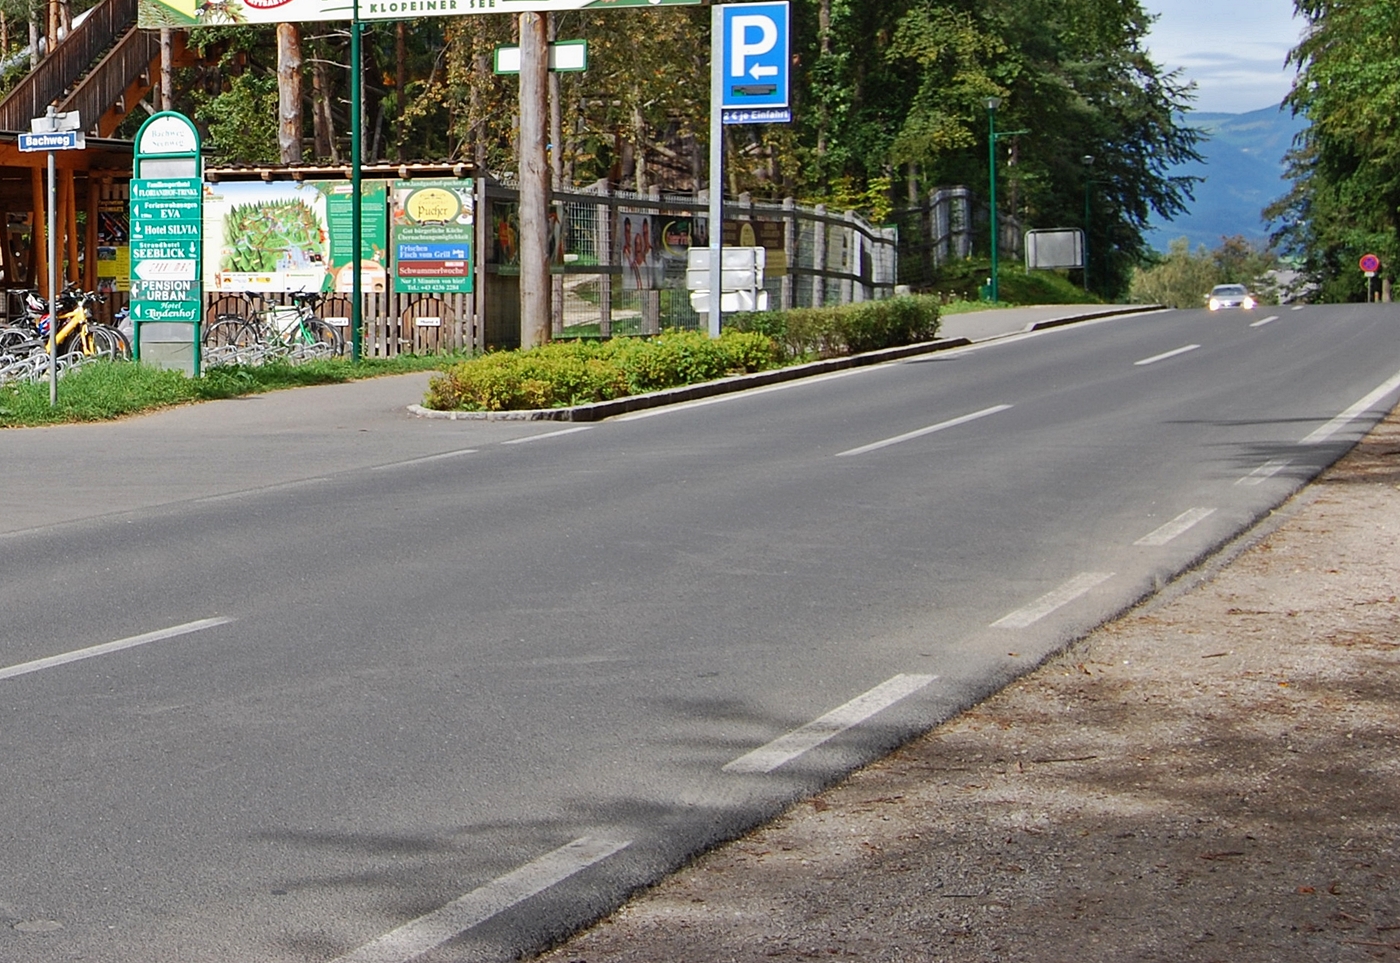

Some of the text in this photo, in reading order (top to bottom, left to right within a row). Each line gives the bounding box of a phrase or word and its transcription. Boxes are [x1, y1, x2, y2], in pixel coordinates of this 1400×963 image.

[370, 0, 457, 13] KLOPEINER
[731, 15, 778, 77] P
[739, 111, 749, 121] je
[751, 109, 788, 120] Einfahrt
[25, 135, 70, 147] Bachweg
[160, 209, 180, 218] EVA
[418, 205, 448, 218] Pucher
[144, 225, 167, 235] Hotel
[167, 224, 198, 235] SILVIA
[139, 241, 180, 249] Strandhotel
[133, 248, 185, 258] SEEBLICK
[434, 250, 451, 258] Grill
[399, 267, 464, 275] Schwammerlwoche
[141, 281, 191, 291] PENSION
[146, 290, 186, 301] URBAN
[144, 308, 196, 320] Lindenhof
